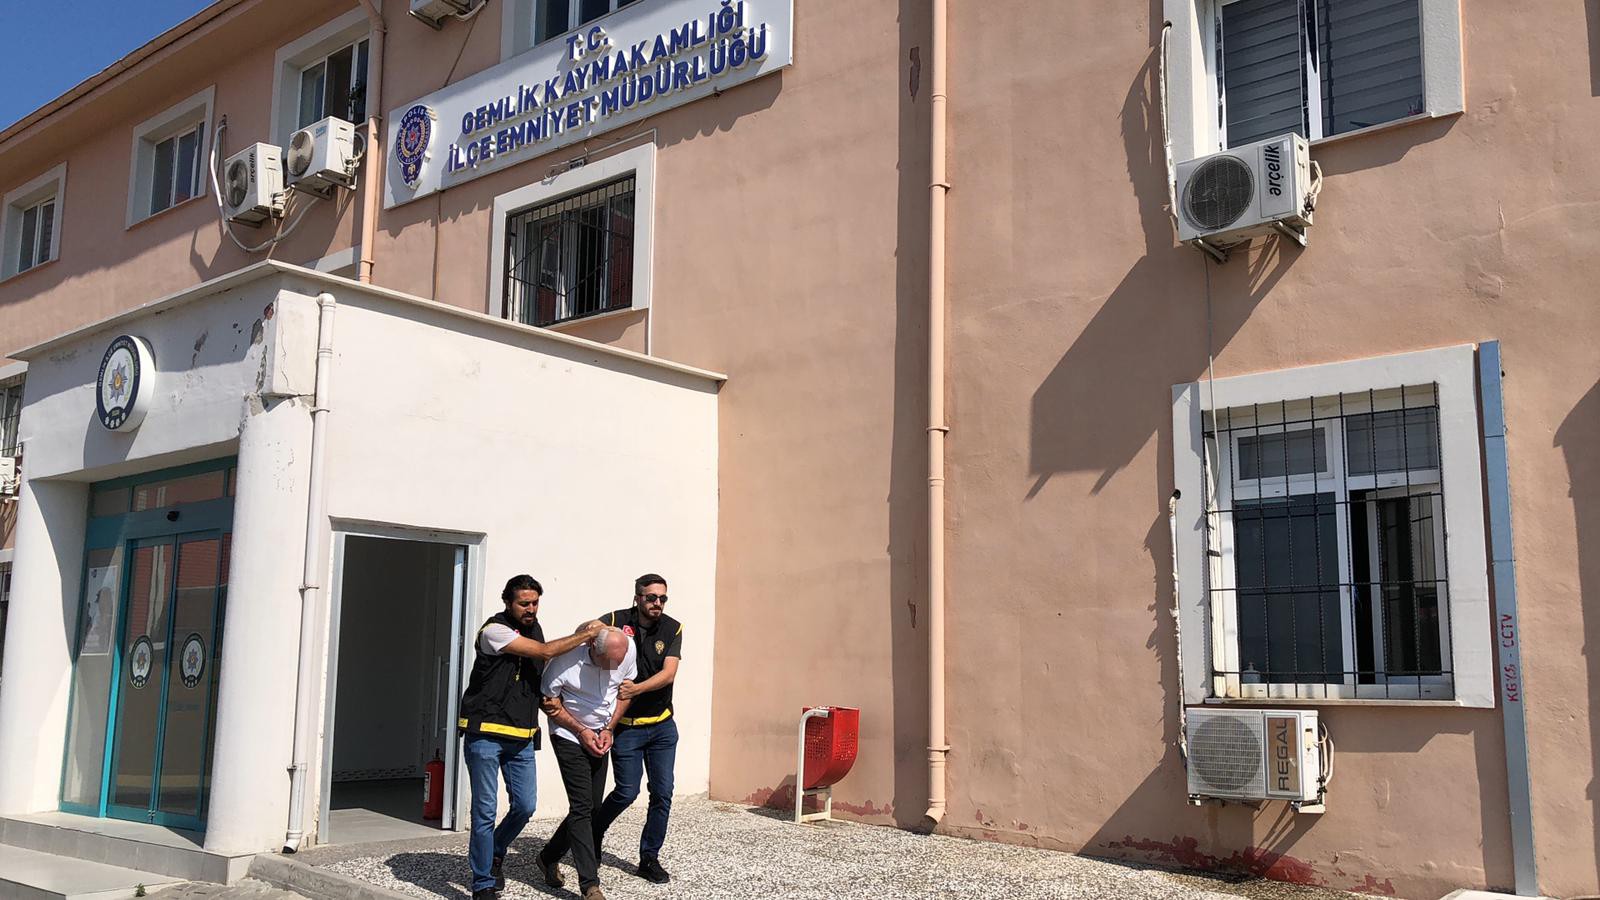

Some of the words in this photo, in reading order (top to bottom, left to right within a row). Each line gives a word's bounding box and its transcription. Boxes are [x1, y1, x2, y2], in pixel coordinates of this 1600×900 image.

[462, 84, 539, 135] GEMLİK
[544, 0, 743, 103] KAYMAKAMLIĞI
[566, 26, 608, 60] T.C.
[448, 143, 491, 173] İLÇE
[496, 96, 597, 155] EMNİYET
[601, 23, 766, 116] MÜDÜRLÜĞÜ
[1265, 145, 1284, 196] arçelik
[1501, 614, 1514, 648] CCTV
[1276, 718, 1290, 791] REGAL
